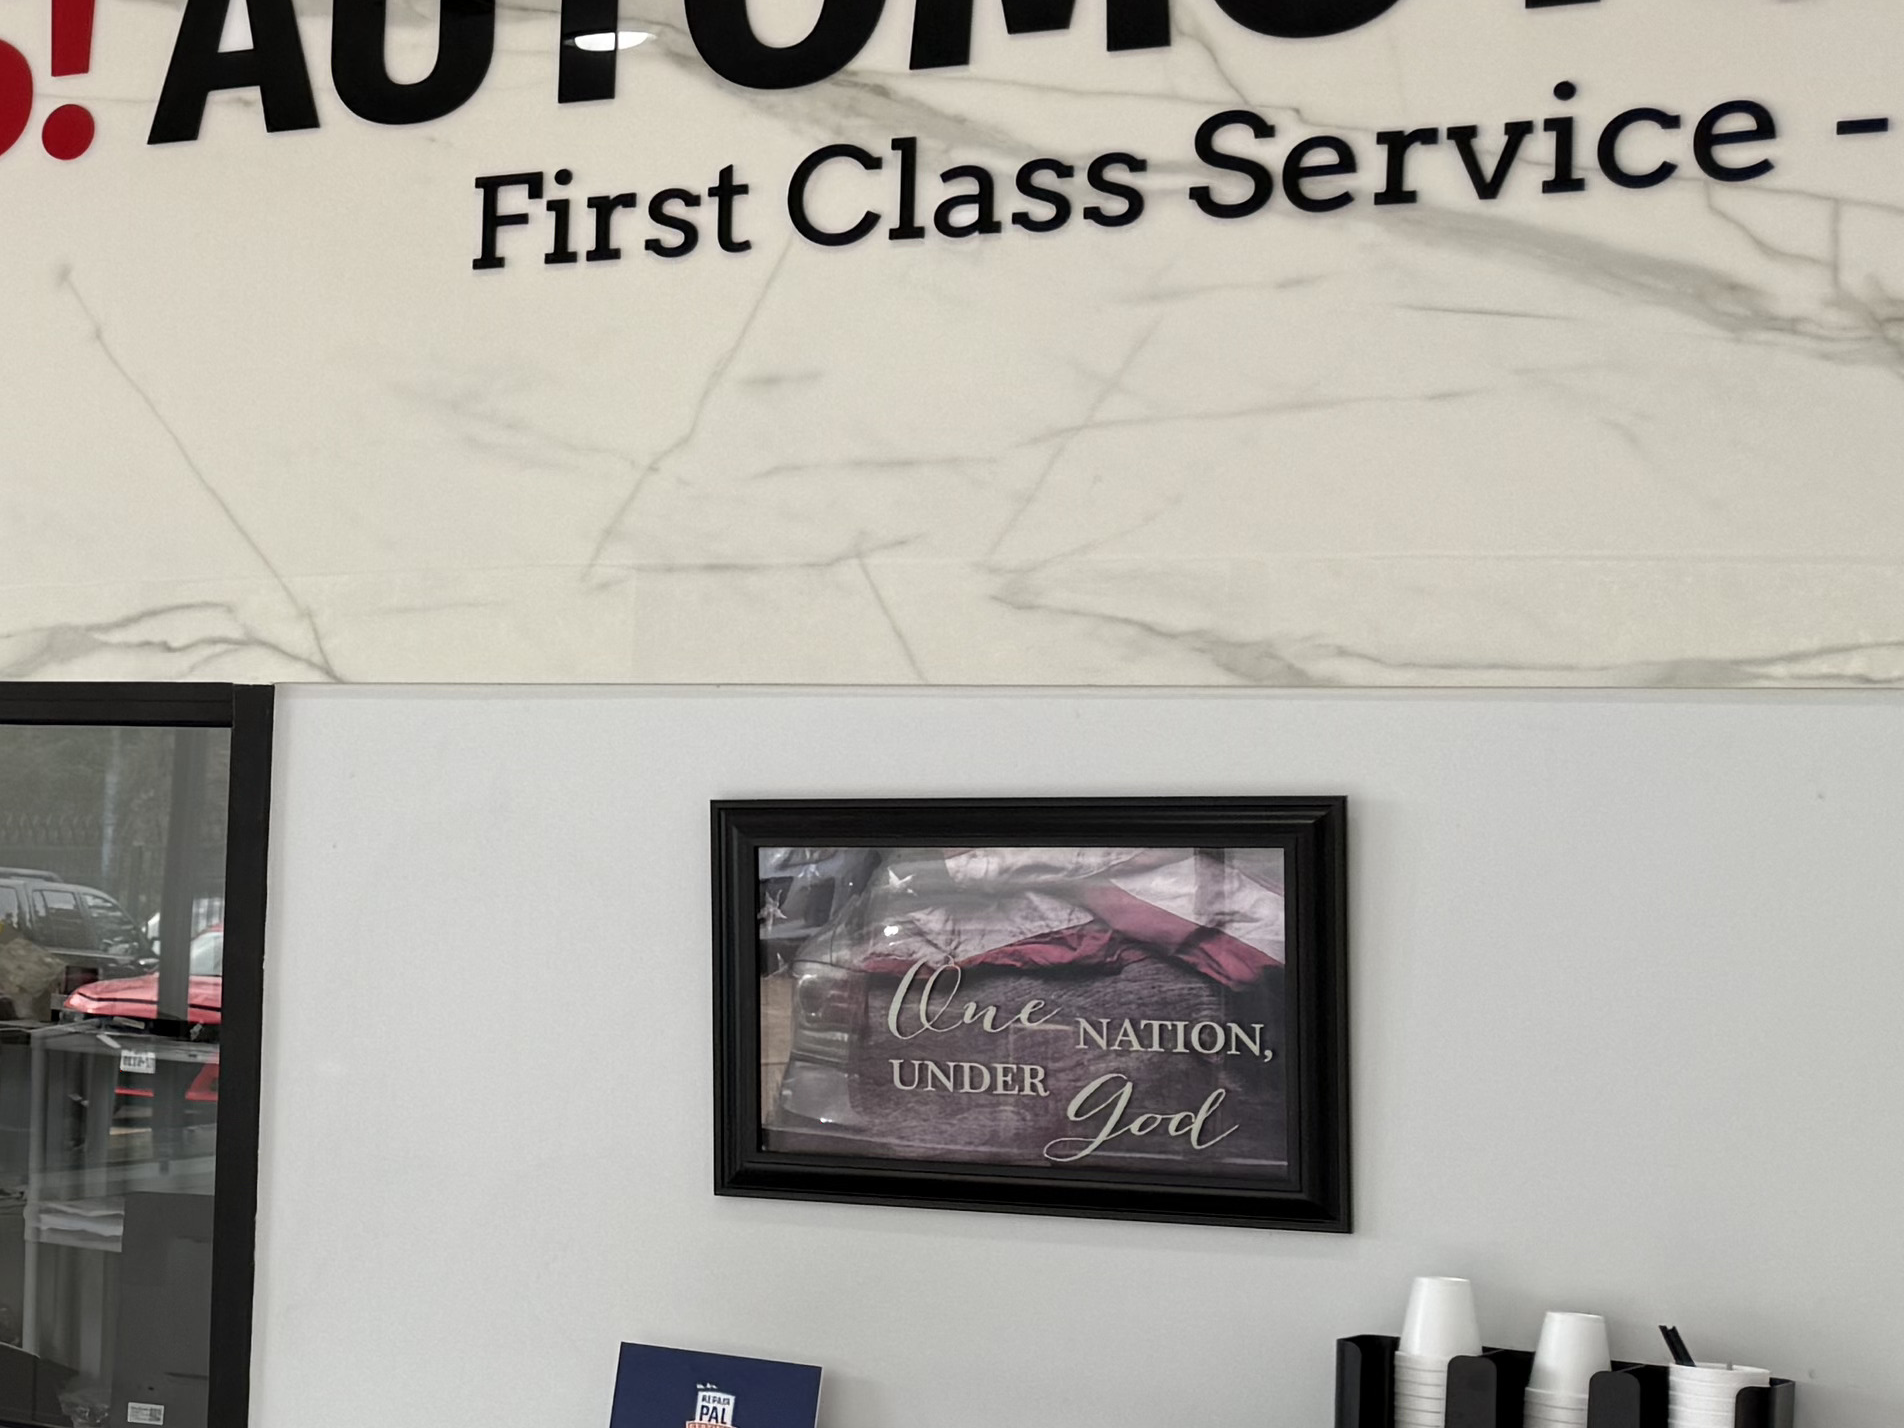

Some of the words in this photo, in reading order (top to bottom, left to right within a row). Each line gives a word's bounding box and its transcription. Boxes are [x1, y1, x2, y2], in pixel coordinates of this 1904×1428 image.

[471, 164, 751, 271] First
[787, 137, 1149, 249] Class
[1189, 81, 1777, 222] Service
[888, 954, 1062, 1040] One
[1075, 1018, 1274, 1063] NATION,
[888, 1059, 1050, 1097] UNDER
[1043, 1073, 1239, 1162] God
[699, 1405, 727, 1425] PAL
